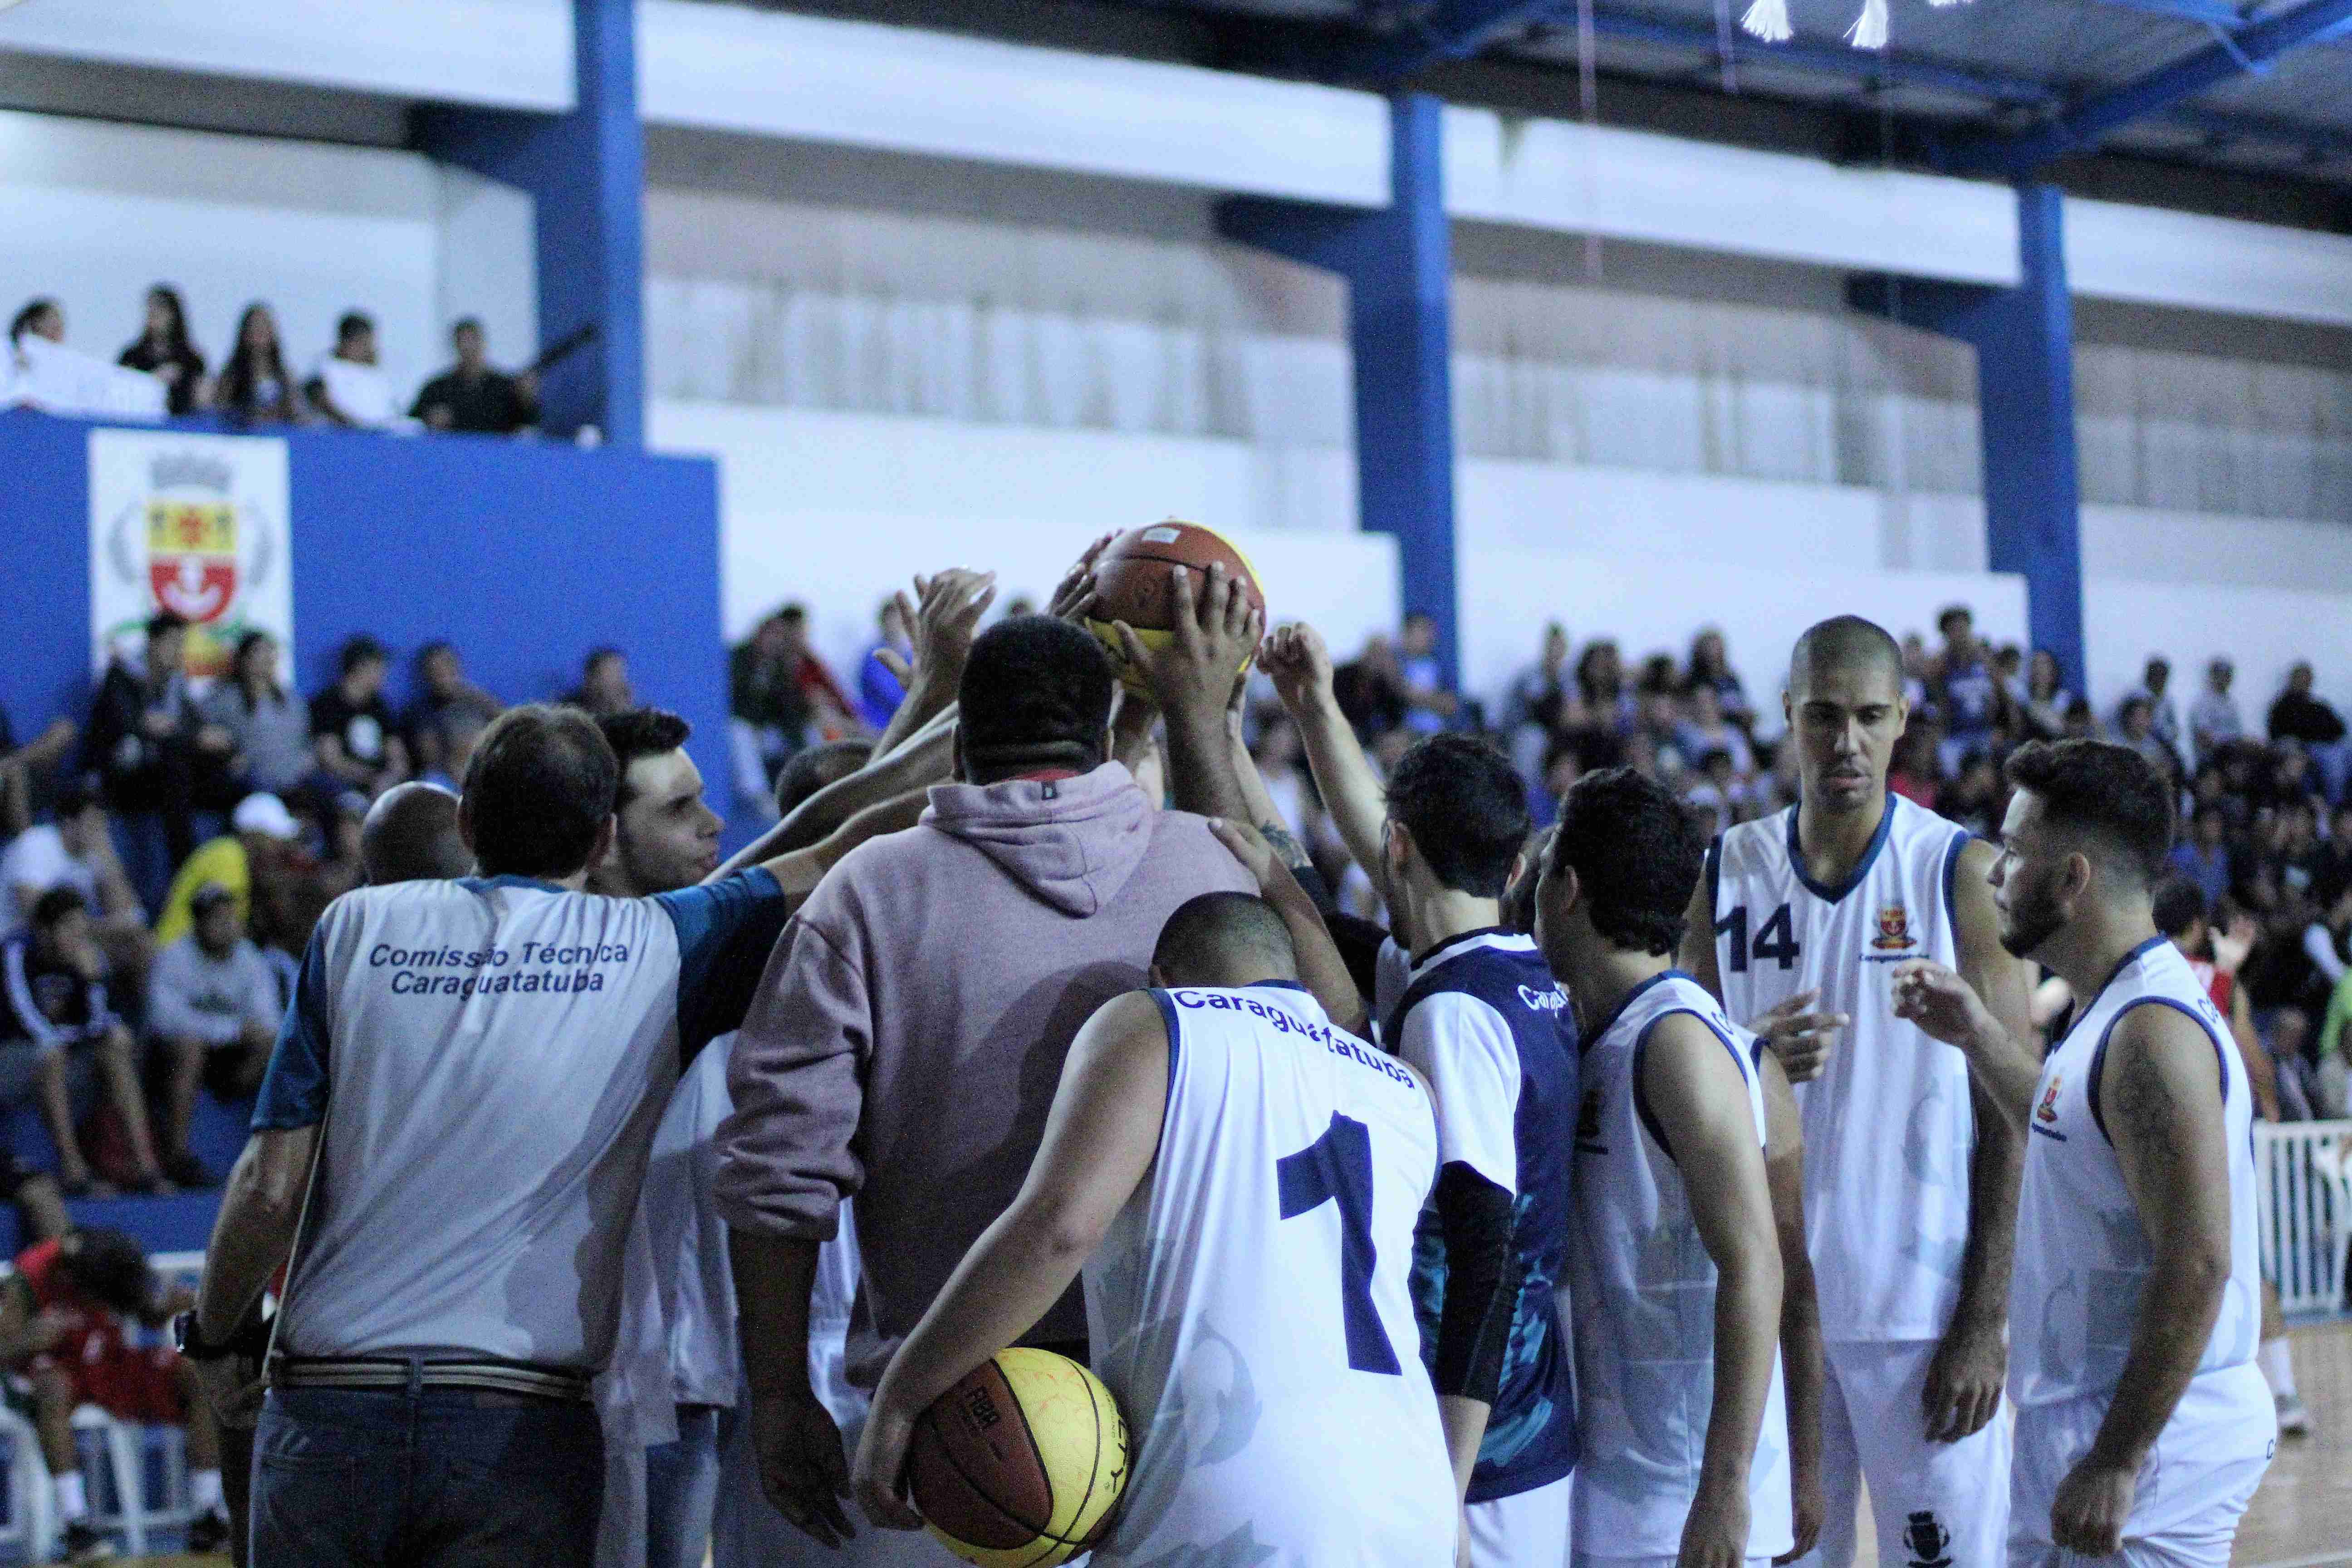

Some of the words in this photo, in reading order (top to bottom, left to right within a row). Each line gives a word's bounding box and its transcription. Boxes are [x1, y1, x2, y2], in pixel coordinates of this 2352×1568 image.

[522, 942, 629, 966] Técnica
[1715, 903, 1800, 972] 14
[391, 969, 604, 999] Caraguatatuba
[1276, 1110, 1403, 1376] 1
